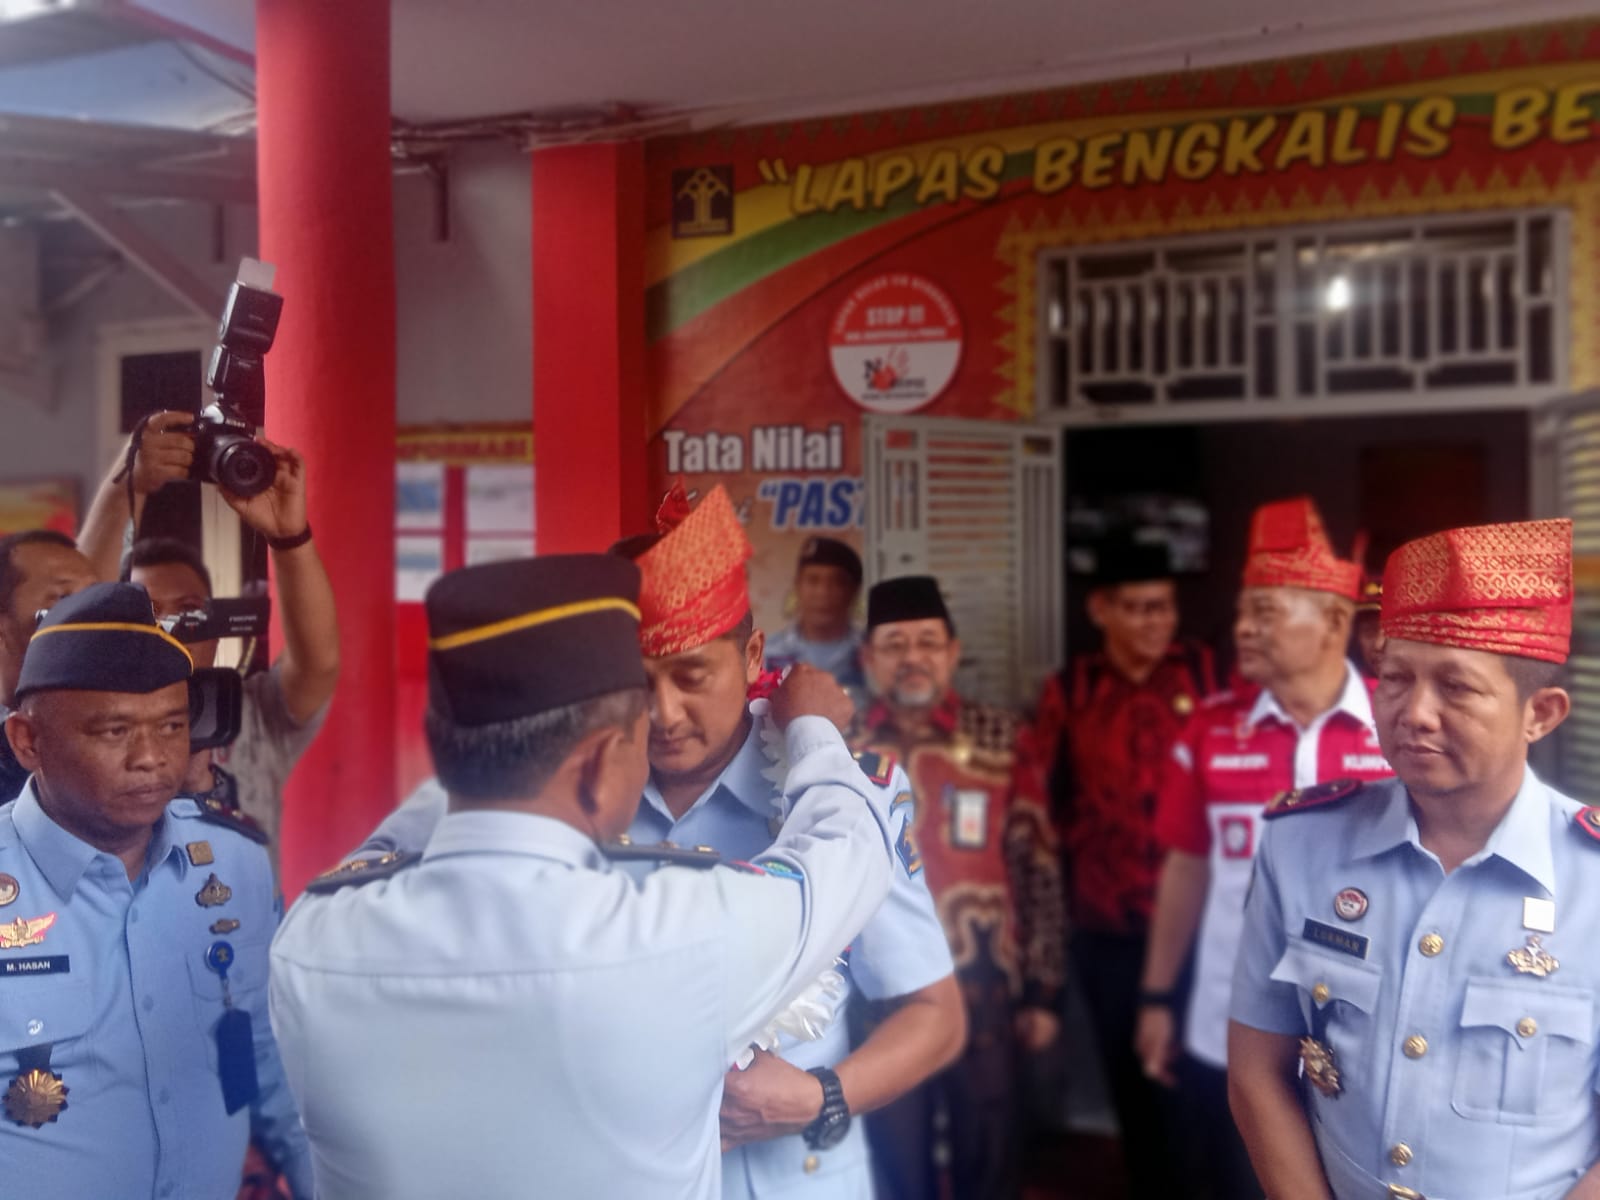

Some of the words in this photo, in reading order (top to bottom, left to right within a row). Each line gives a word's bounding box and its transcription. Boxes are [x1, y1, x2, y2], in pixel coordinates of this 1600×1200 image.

[1033, 95, 1456, 195] BENGKALIS
[1491, 81, 1600, 150] BE
[866, 305, 905, 326] STOP
[663, 430, 744, 473] Tata
[752, 424, 843, 471] Nilai
[6, 962, 17, 972] M.
